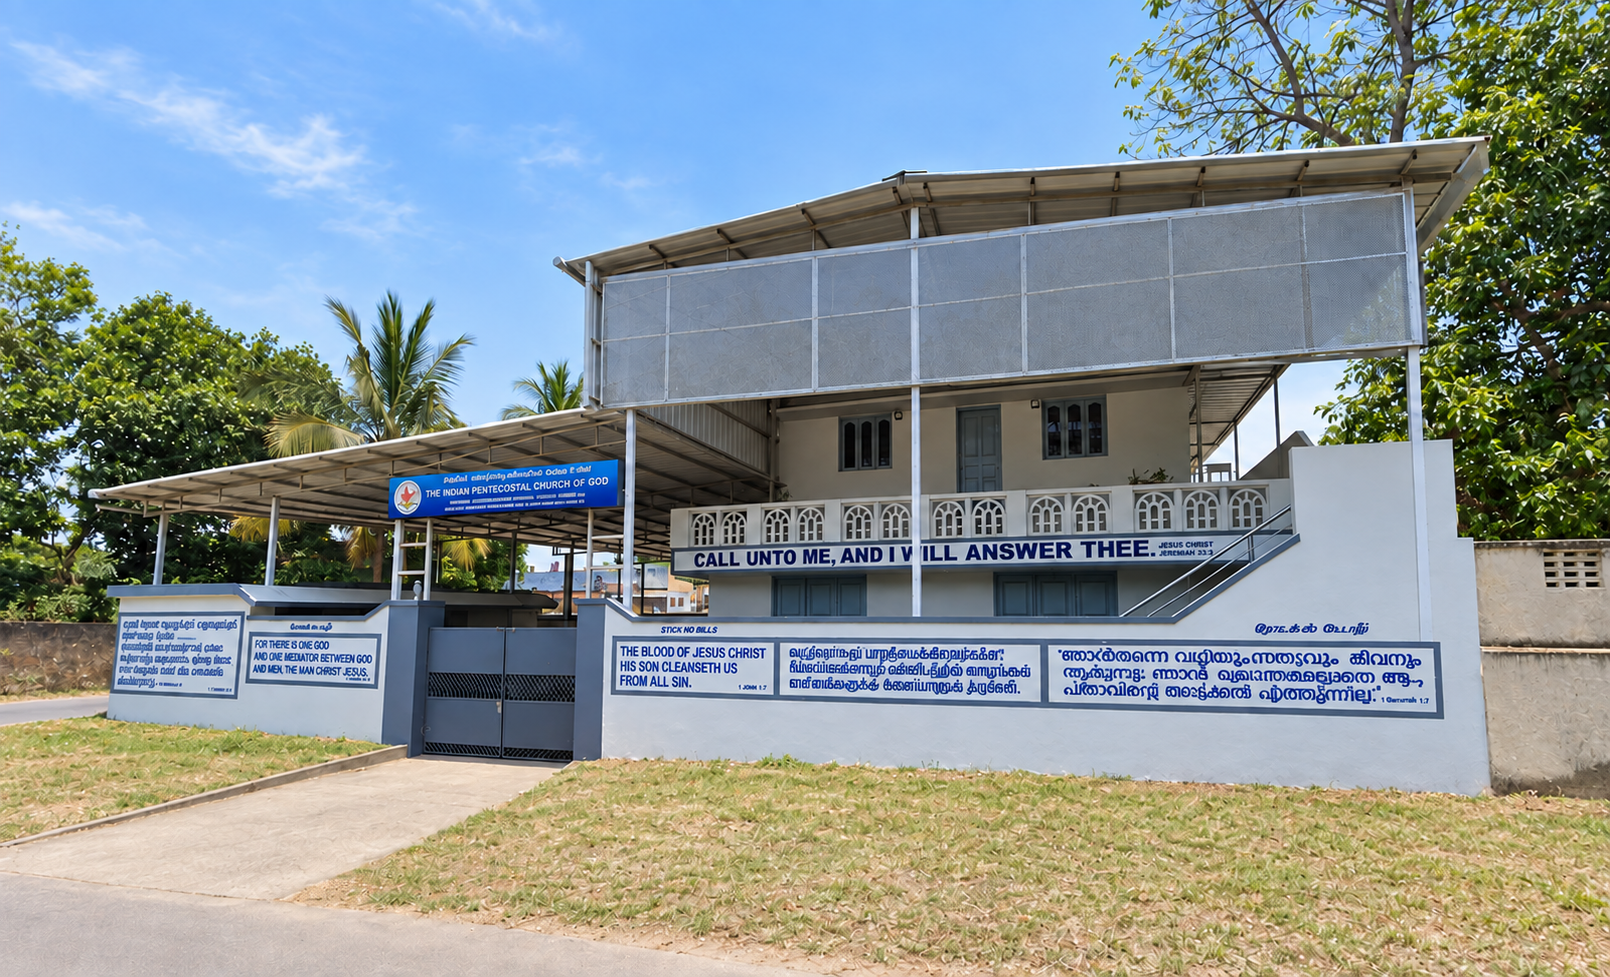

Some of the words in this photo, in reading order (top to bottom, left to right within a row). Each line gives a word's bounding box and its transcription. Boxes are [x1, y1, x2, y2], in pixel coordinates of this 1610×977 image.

[426, 489, 440, 497] THE
[443, 488, 469, 496] INDIAN
[472, 483, 531, 494] PENTECOSTAL
[534, 480, 570, 490] CHURCH
[573, 479, 585, 487] OF
[588, 477, 608, 486] GOD
[694, 552, 740, 567] CALL
[746, 550, 797, 566] UNTO
[803, 549, 837, 567] ME,
[840, 547, 883, 564] AND
[889, 546, 895, 562] I
[965, 541, 1073, 561] ANSWER
[1080, 540, 1156, 558] THEE.
[255, 640, 268, 648] FOR
[269, 640, 290, 649] THERE
[299, 641, 312, 649] ONE
[314, 641, 329, 650] GOD
[254, 652, 268, 661] AND
[269, 652, 283, 661] ONE
[320, 654, 355, 663] BETWEEN
[357, 654, 372, 663] GOD
[620, 646, 639, 656] THE
[642, 646, 674, 657] BLOOD
[677, 647, 690, 657] OF
[693, 647, 725, 658] JESUS
[728, 648, 766, 659] CHRIST
[253, 665, 266, 673] AND
[285, 665, 297, 674] THE
[299, 666, 314, 674] MAN
[316, 667, 341, 675] CHRIST
[343, 667, 368, 677] JESUS.
[621, 661, 636, 671] HIS
[639, 661, 659, 672] SON
[662, 661, 720, 673] CLEANSETH
[724, 663, 737, 674] US
[620, 675, 647, 686] FROM
[650, 676, 669, 687] ALL
[672, 676, 691, 687] SIN.
